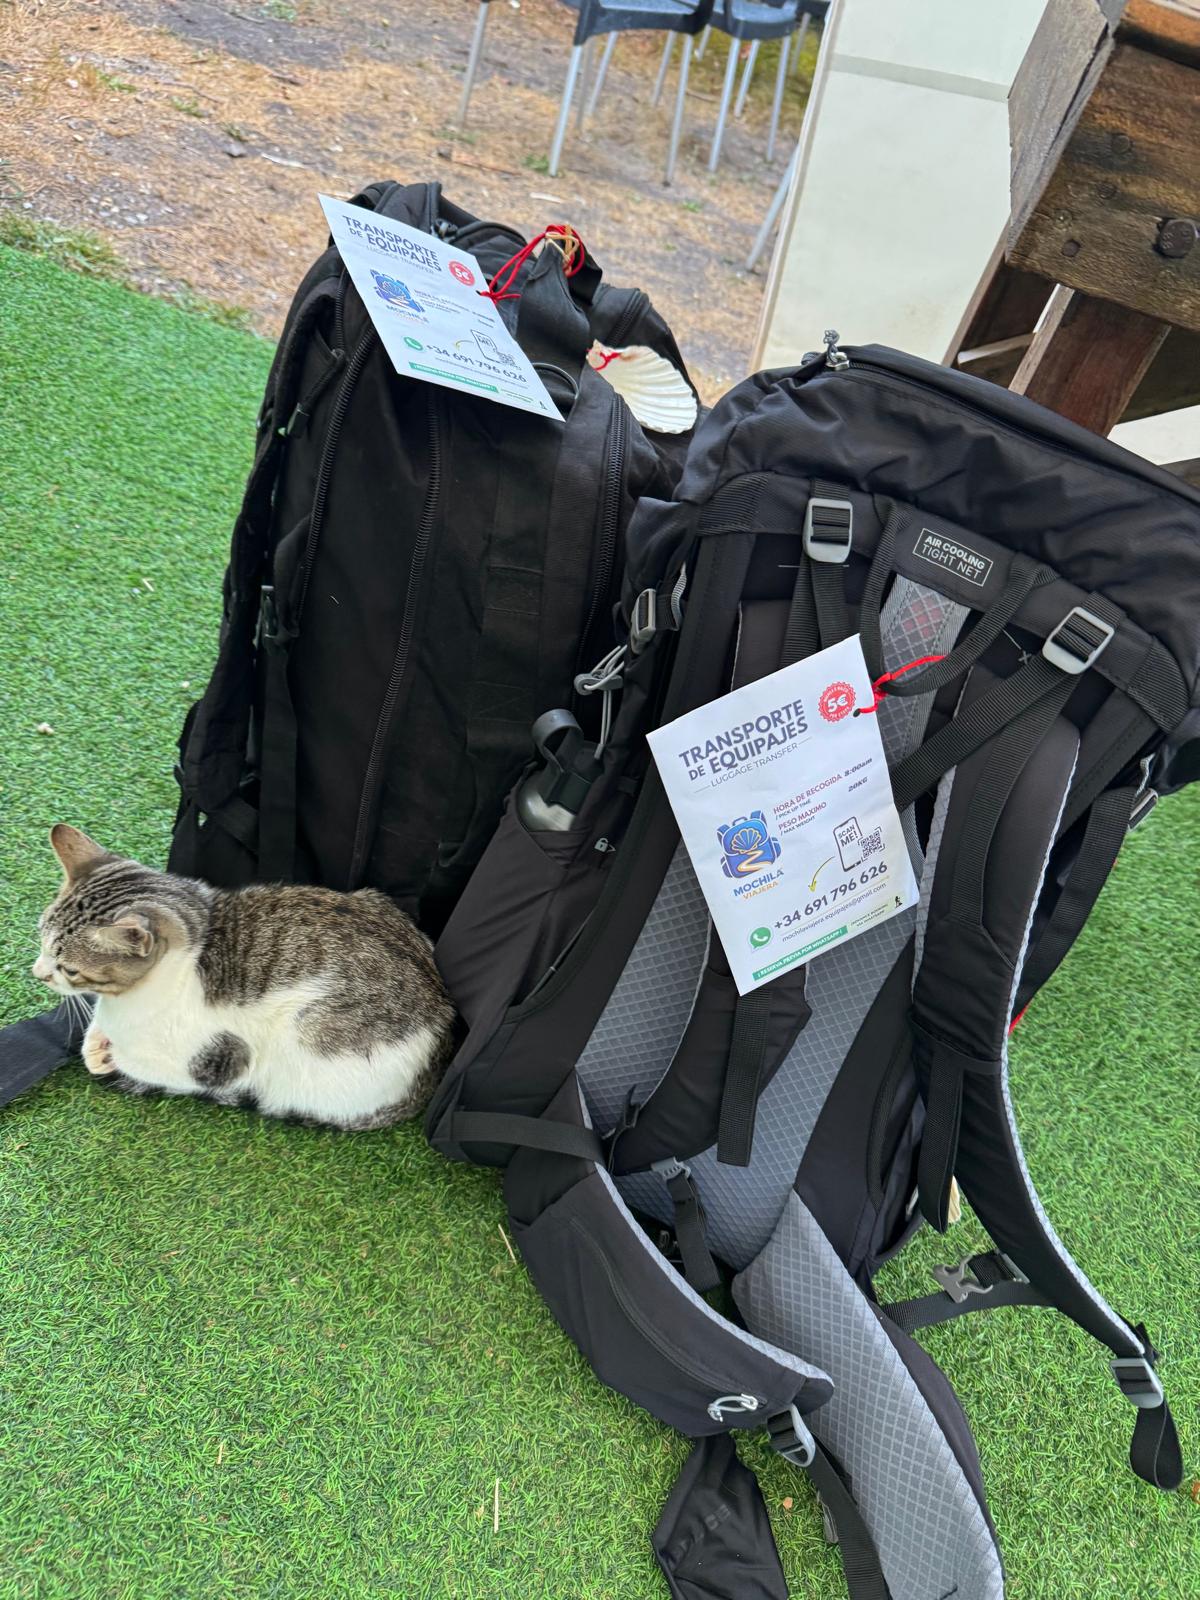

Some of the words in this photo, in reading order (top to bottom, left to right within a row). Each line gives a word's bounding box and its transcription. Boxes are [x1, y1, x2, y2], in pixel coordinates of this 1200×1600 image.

[343, 215, 438, 261] TRANSPORTE
[349, 227, 363, 238] DE
[367, 233, 442, 272] EQUIPAJES
[427, 345, 450, 357] +34
[453, 353, 475, 365] 691
[476, 361, 500, 373] 796
[503, 370, 527, 383] 626
[922, 543, 957, 566] TIGHT
[957, 561, 982, 579] NET
[924, 535, 942, 548] AIR
[942, 543, 986, 570] COOLING
[828, 693, 849, 713] 5€
[678, 699, 804, 768] TRANSPORTE
[688, 765, 706, 781] DE
[708, 716, 809, 774] EQUIPAJES
[710, 761, 753, 788] LUGGAGE
[753, 743, 798, 768] TRANSFER
[773, 799, 796, 815] HORA
[795, 792, 806, 803] DE
[805, 773, 842, 797] RECOGIDA
[844, 758, 873, 777] 8:00am
[848, 776, 868, 792] 20KG
[778, 810, 791, 818] PICK
[799, 799, 811, 808] TIME
[778, 816, 797, 830] PESO
[797, 801, 827, 821] MAXIMO
[783, 826, 796, 834] MAX
[795, 815, 815, 828] WEIGHT
[837, 824, 855, 839] SCAN
[840, 830, 858, 847] ME!
[733, 869, 784, 897] MOCHILA
[742, 881, 779, 899] VIAJERA
[774, 910, 801, 929] +34
[804, 895, 828, 916] 691
[830, 878, 857, 901] 796
[859, 861, 888, 884] 626
[801, 945, 812, 954] POR
